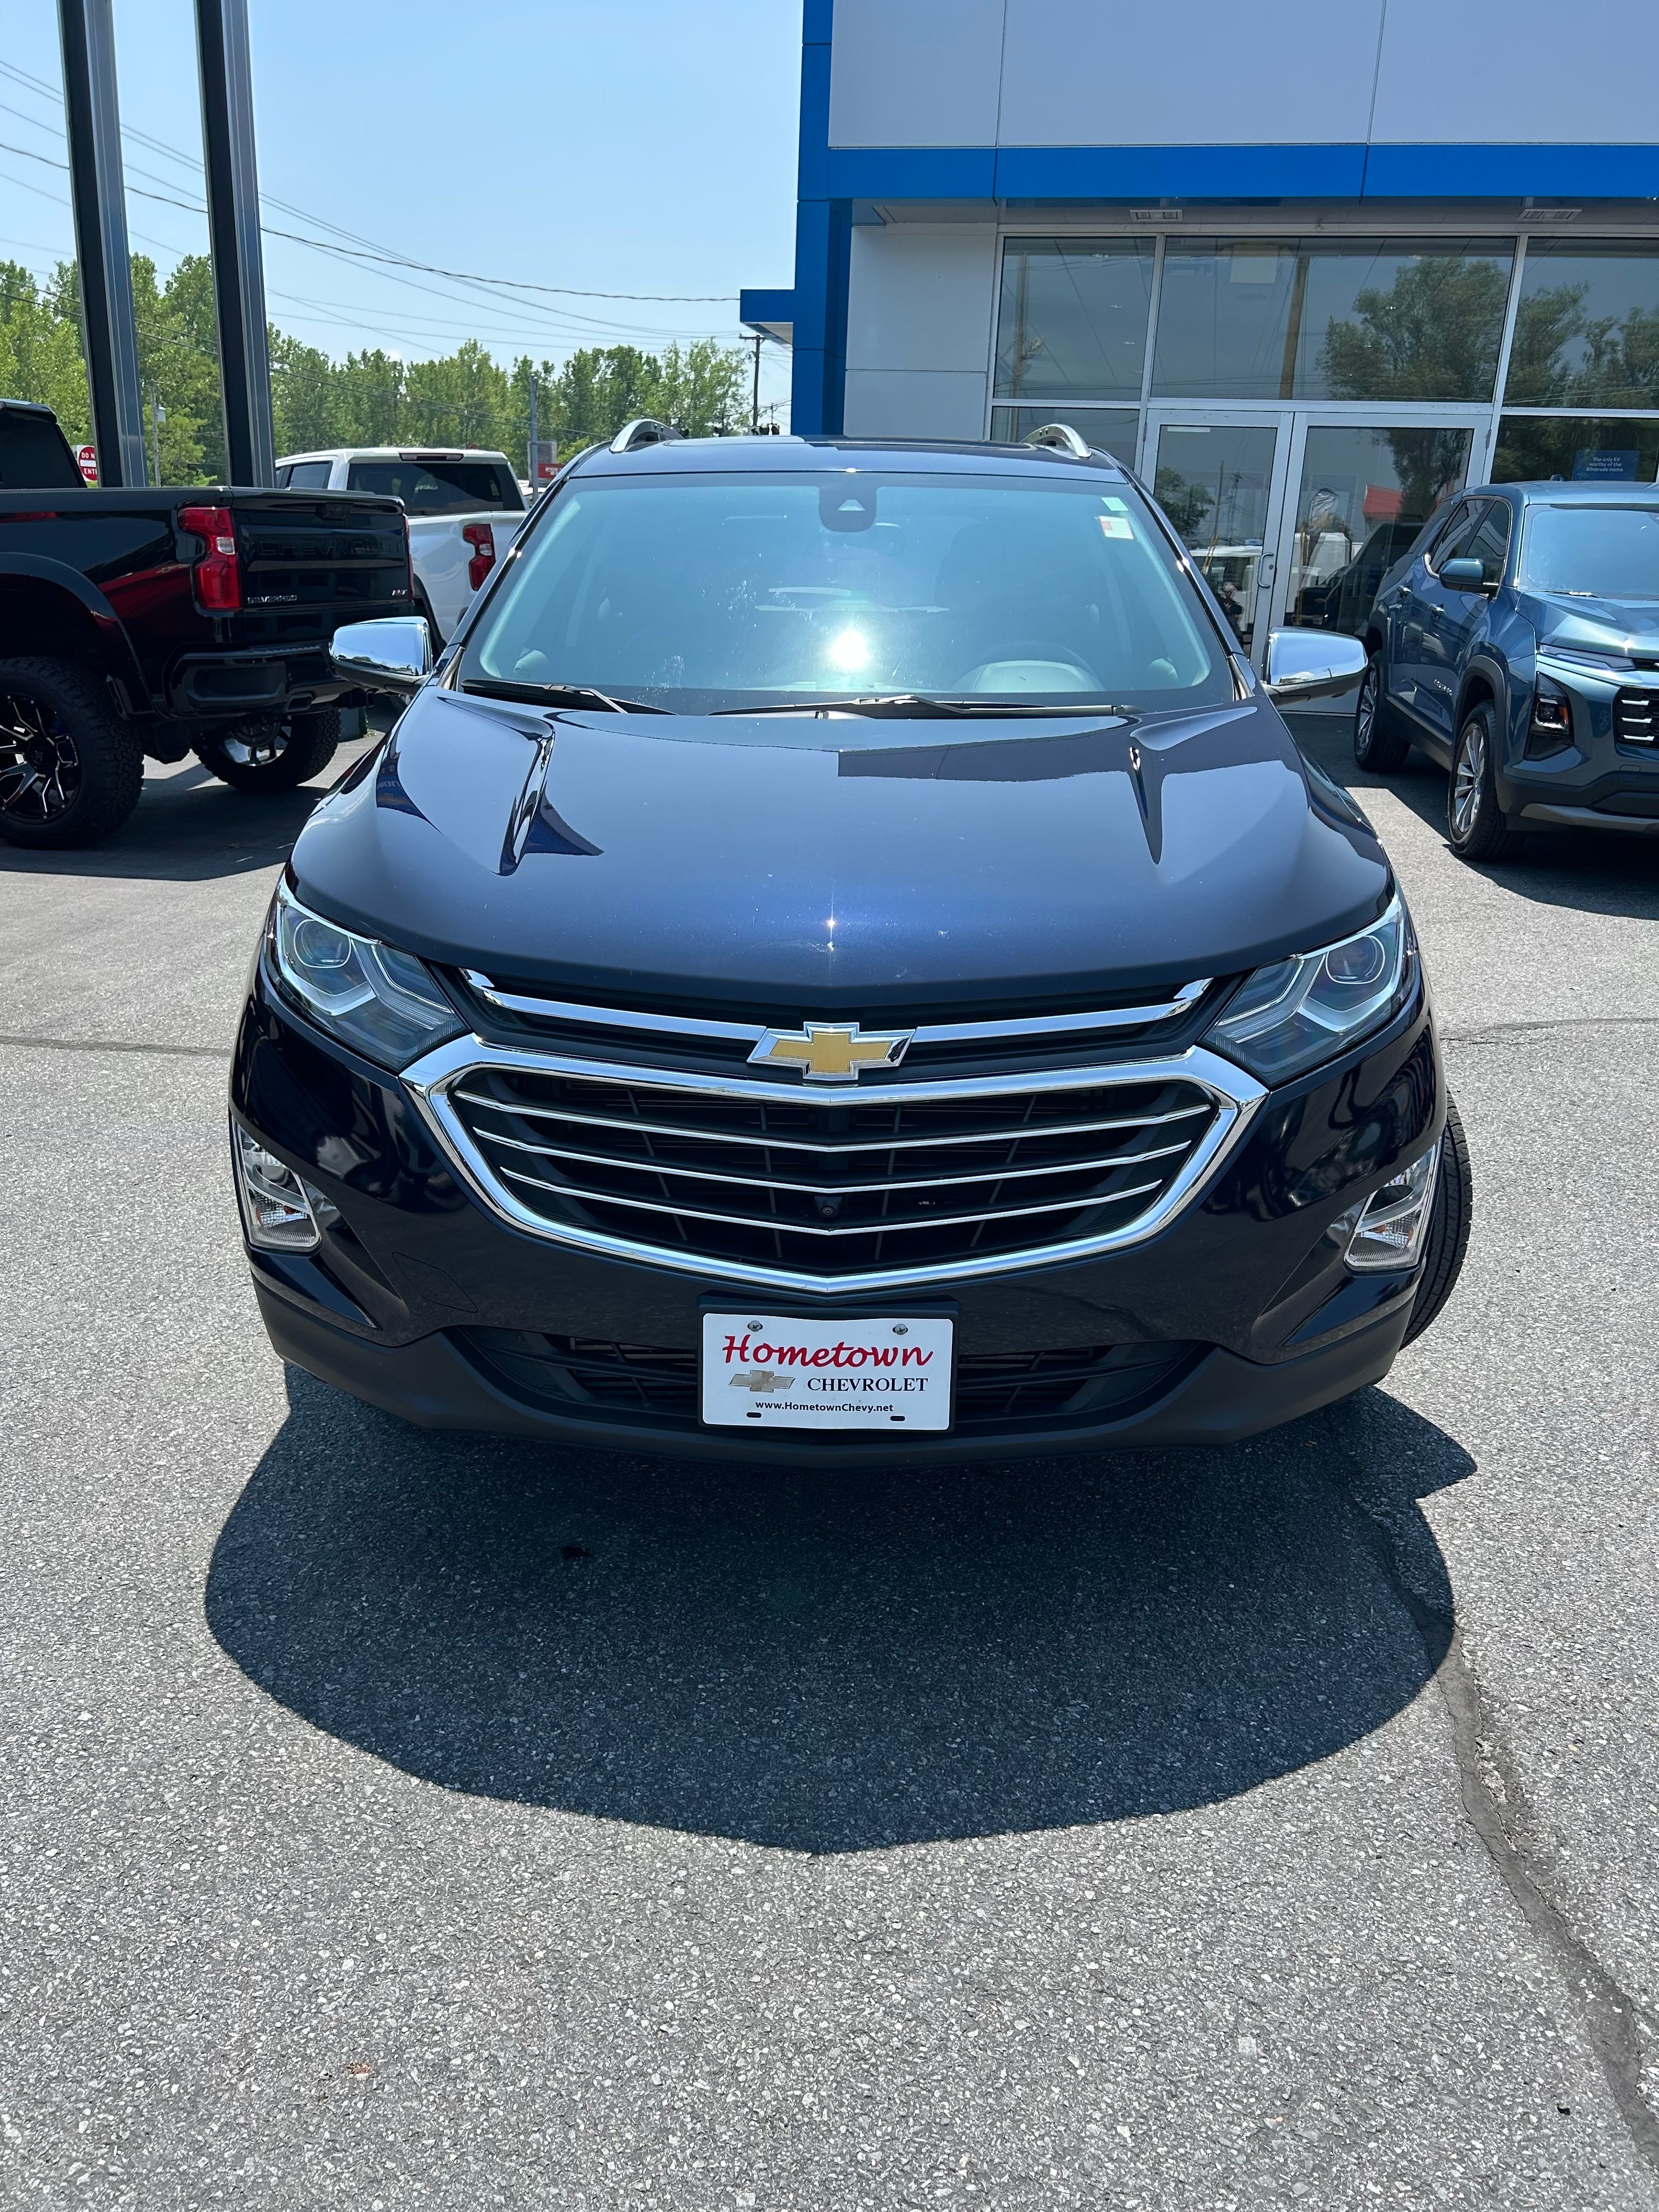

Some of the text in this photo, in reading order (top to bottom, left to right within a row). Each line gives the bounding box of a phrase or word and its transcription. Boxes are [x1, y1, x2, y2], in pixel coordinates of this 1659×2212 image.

[247, 595, 298, 604] SILVERADO
[722, 1334, 933, 1368] Hometown
[806, 1377, 928, 1392] CHEVROLET
[755, 1401, 894, 1414] www.HometownChevy.net
